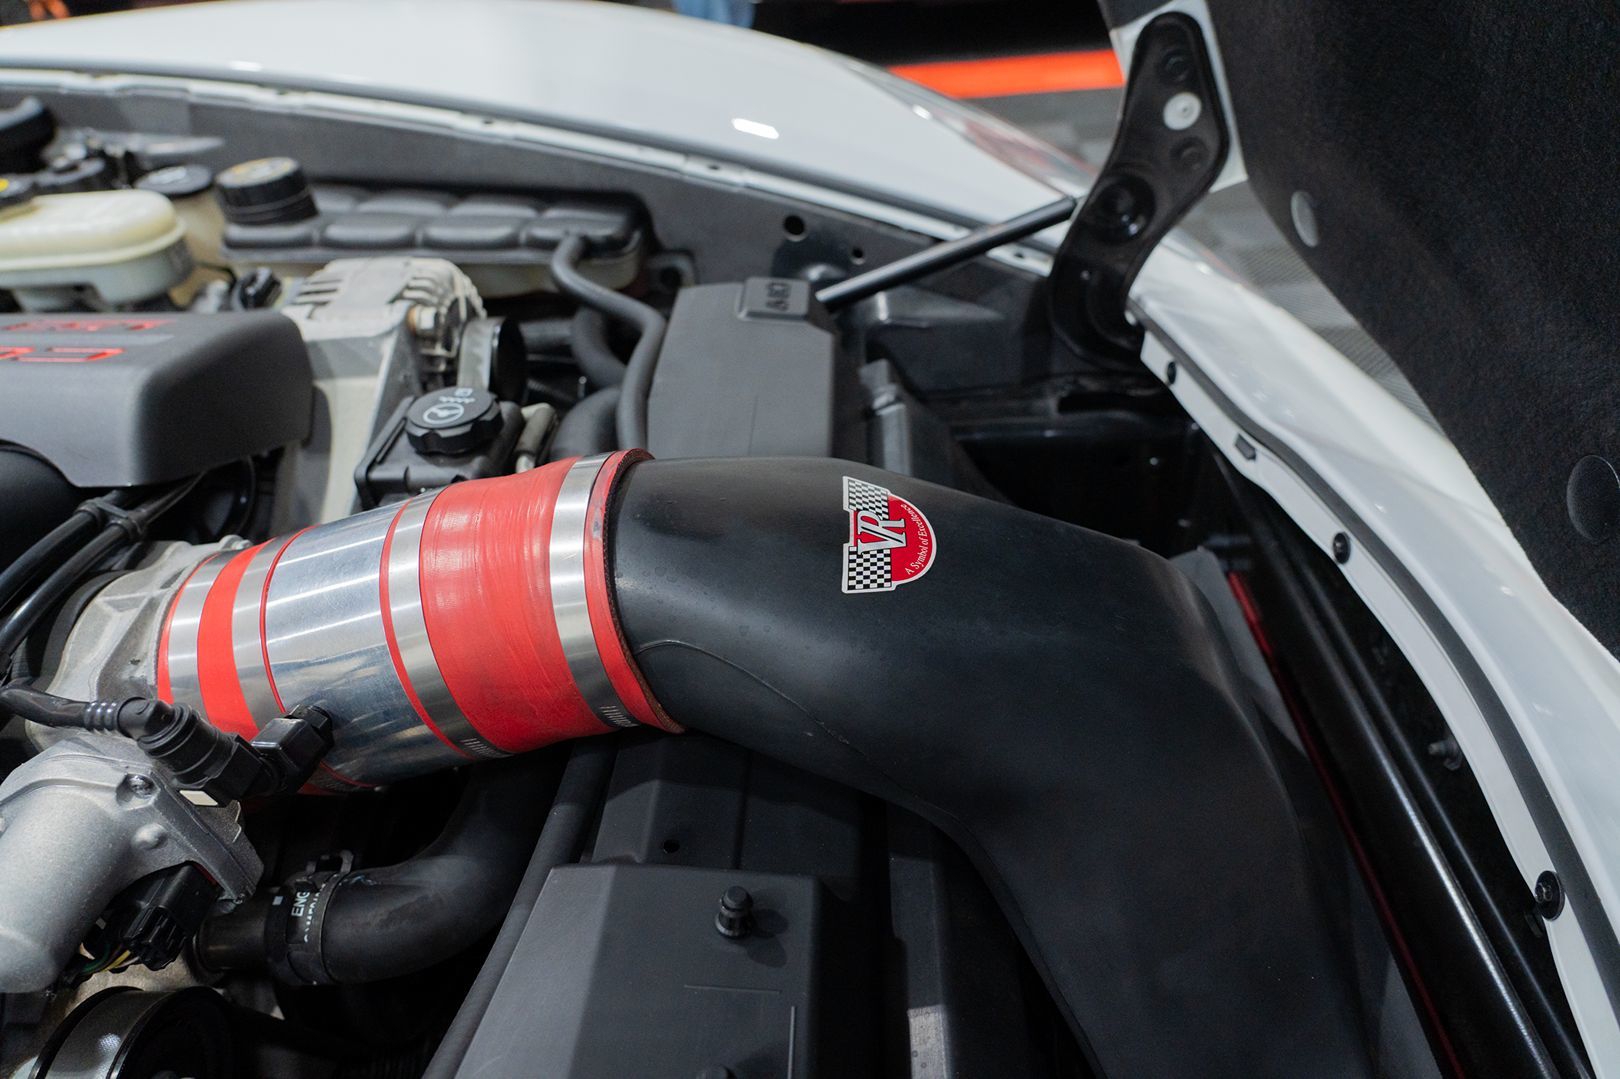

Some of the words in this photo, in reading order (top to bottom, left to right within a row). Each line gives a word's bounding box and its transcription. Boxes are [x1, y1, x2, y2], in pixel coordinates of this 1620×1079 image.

[857, 510, 907, 555] VR
[918, 536, 929, 545] of
[910, 545, 929, 570] Symbol
[904, 567, 915, 575] A
